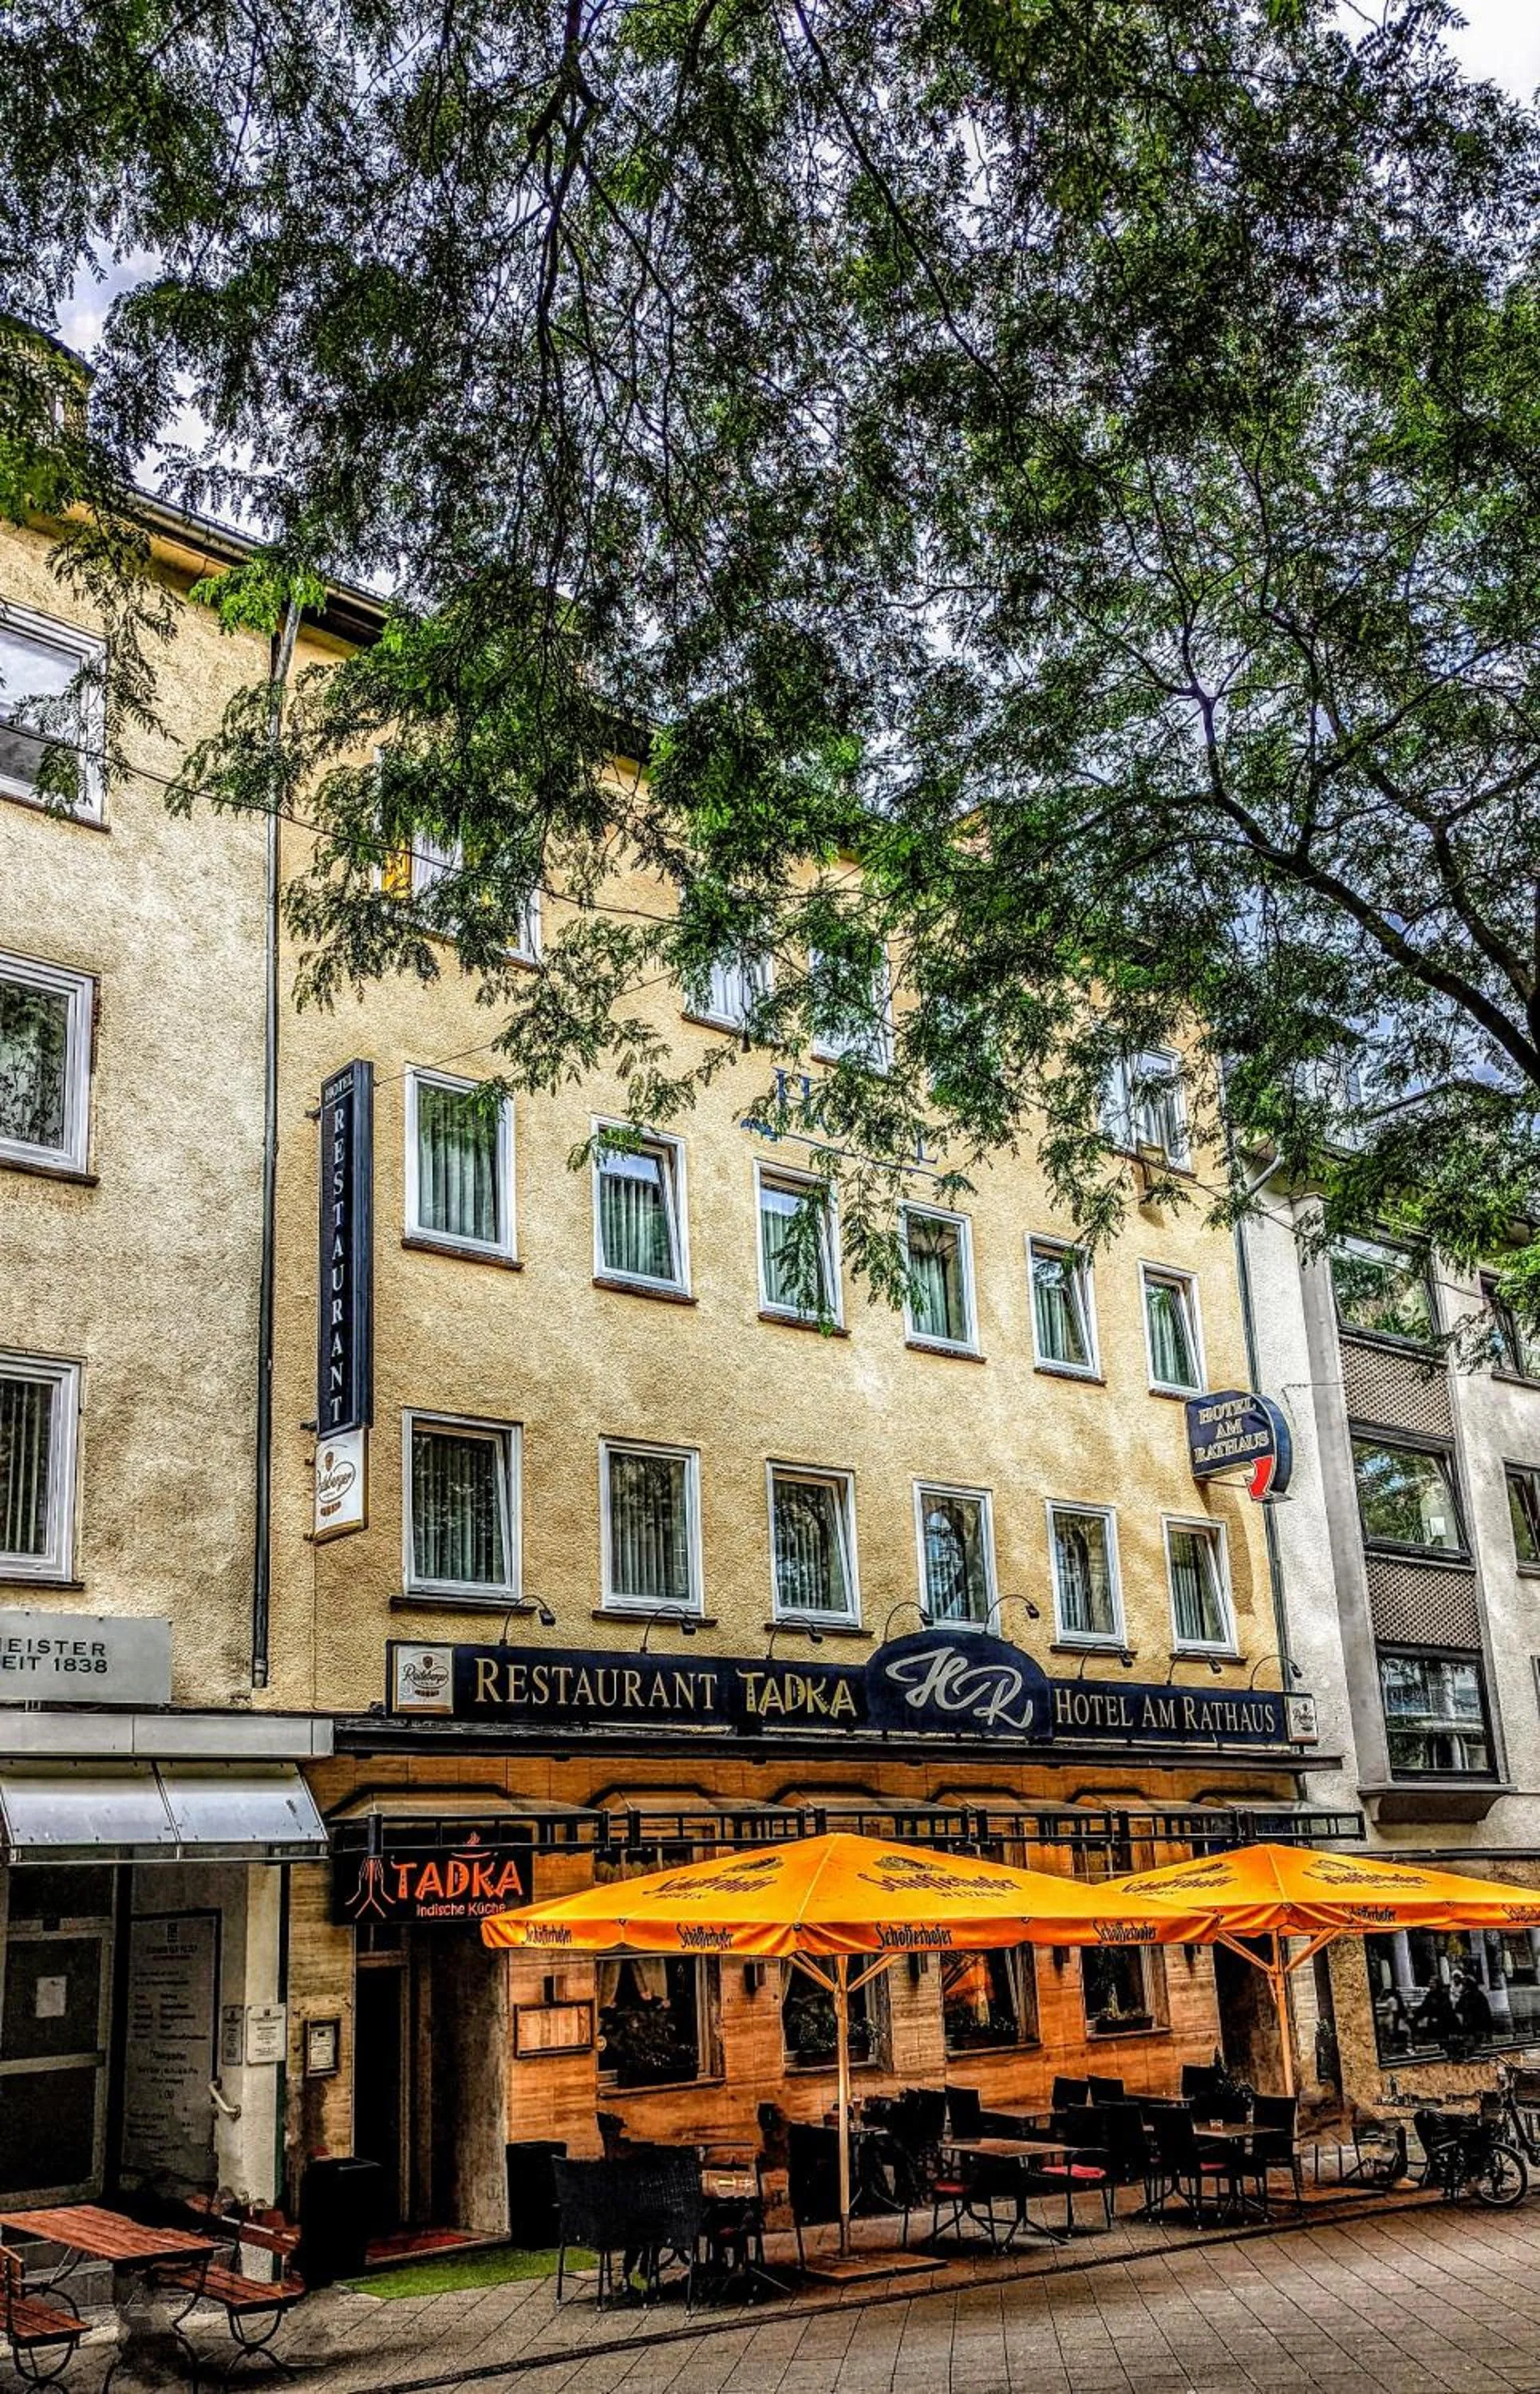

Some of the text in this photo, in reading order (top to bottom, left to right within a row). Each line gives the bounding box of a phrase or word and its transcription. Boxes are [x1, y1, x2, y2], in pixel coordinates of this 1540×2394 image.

[325, 1073, 353, 1102] HOTEL
[330, 1104, 346, 1424] RESTAURANT
[1198, 1397, 1256, 1424] HOTEL
[1215, 1417, 1243, 1439] AM
[1194, 1431, 1270, 1464] RATHAUS
[0, 1637, 105, 1657] EISTER
[53, 1657, 108, 1673] 1838
[473, 1657, 718, 1711] RESTAURANT
[735, 1668, 858, 1719] TADKA
[1054, 1688, 1134, 1727] HOTEL
[1141, 1694, 1176, 1730] AM
[1184, 1696, 1275, 1733] RATHAUS
[391, 1855, 523, 1900] TADKA
[417, 1901, 507, 1918] Indische Küche
